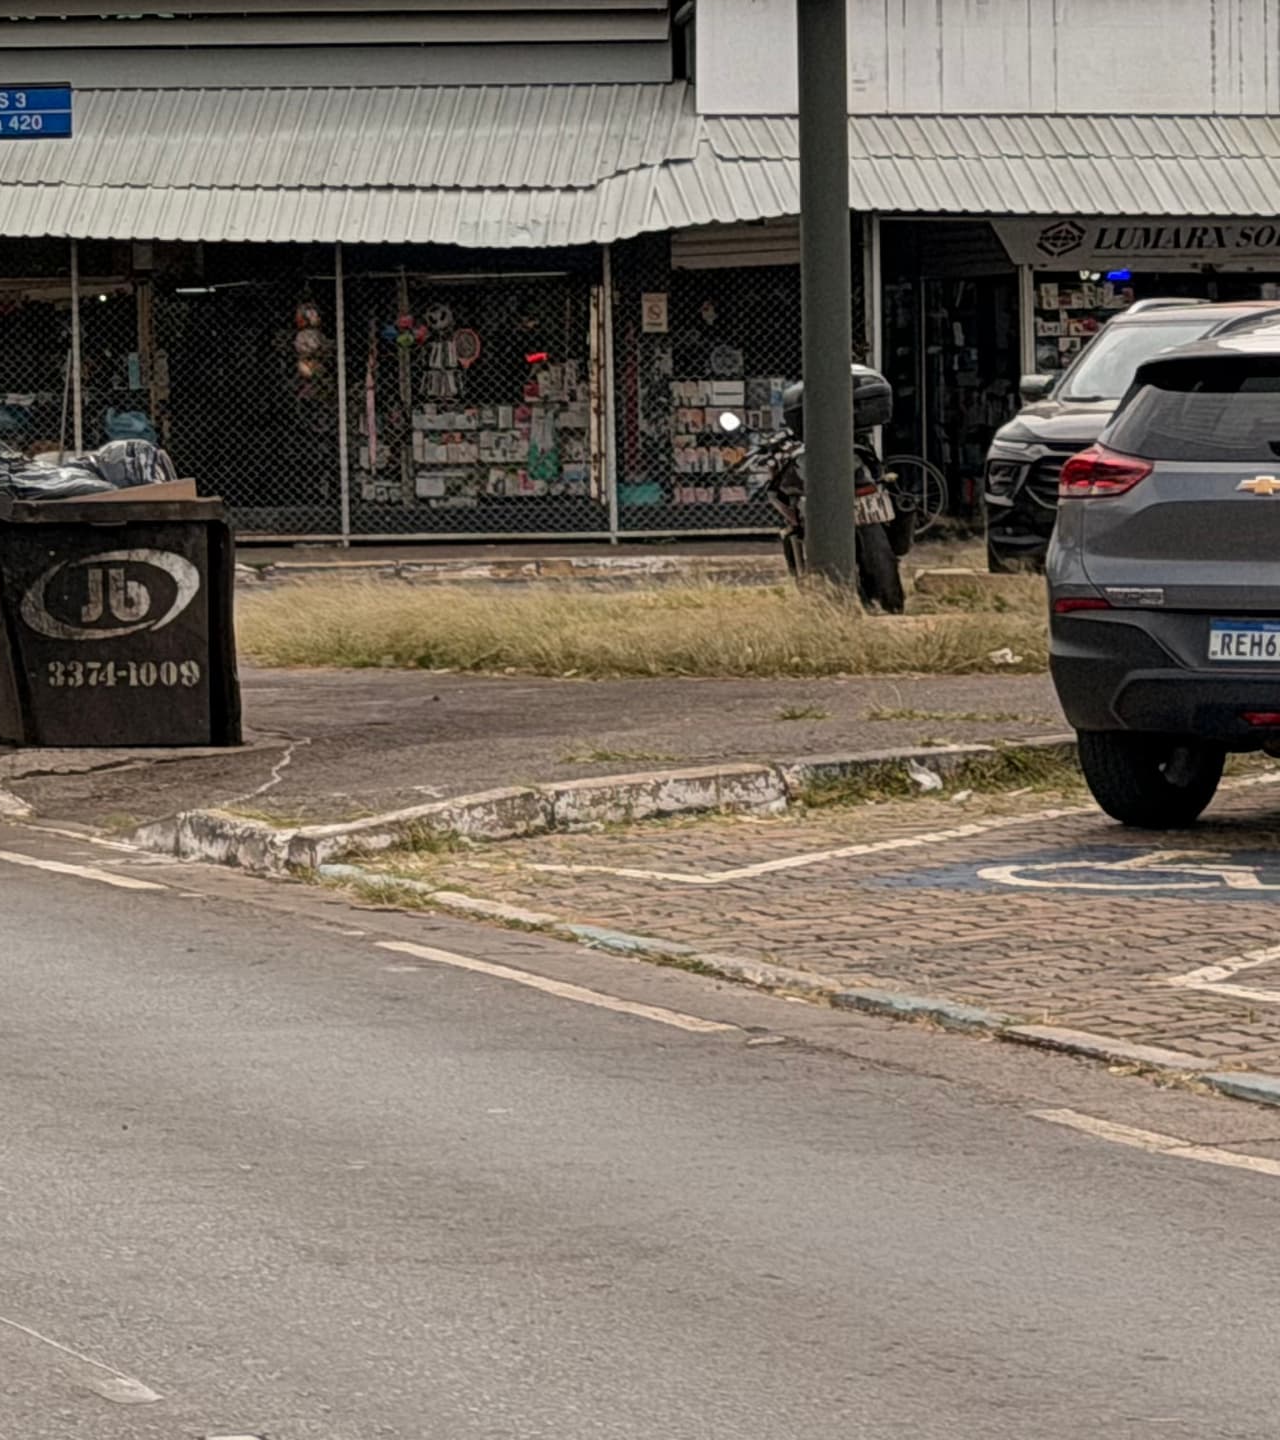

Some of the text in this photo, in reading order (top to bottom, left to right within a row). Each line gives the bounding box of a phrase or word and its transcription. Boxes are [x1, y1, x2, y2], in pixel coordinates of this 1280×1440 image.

[15, 92, 27, 108] 3
[8, 115, 42, 130] 420
[1093, 224, 1280, 250] LUMARX SO
[1220, 632, 1280, 657] REH6
